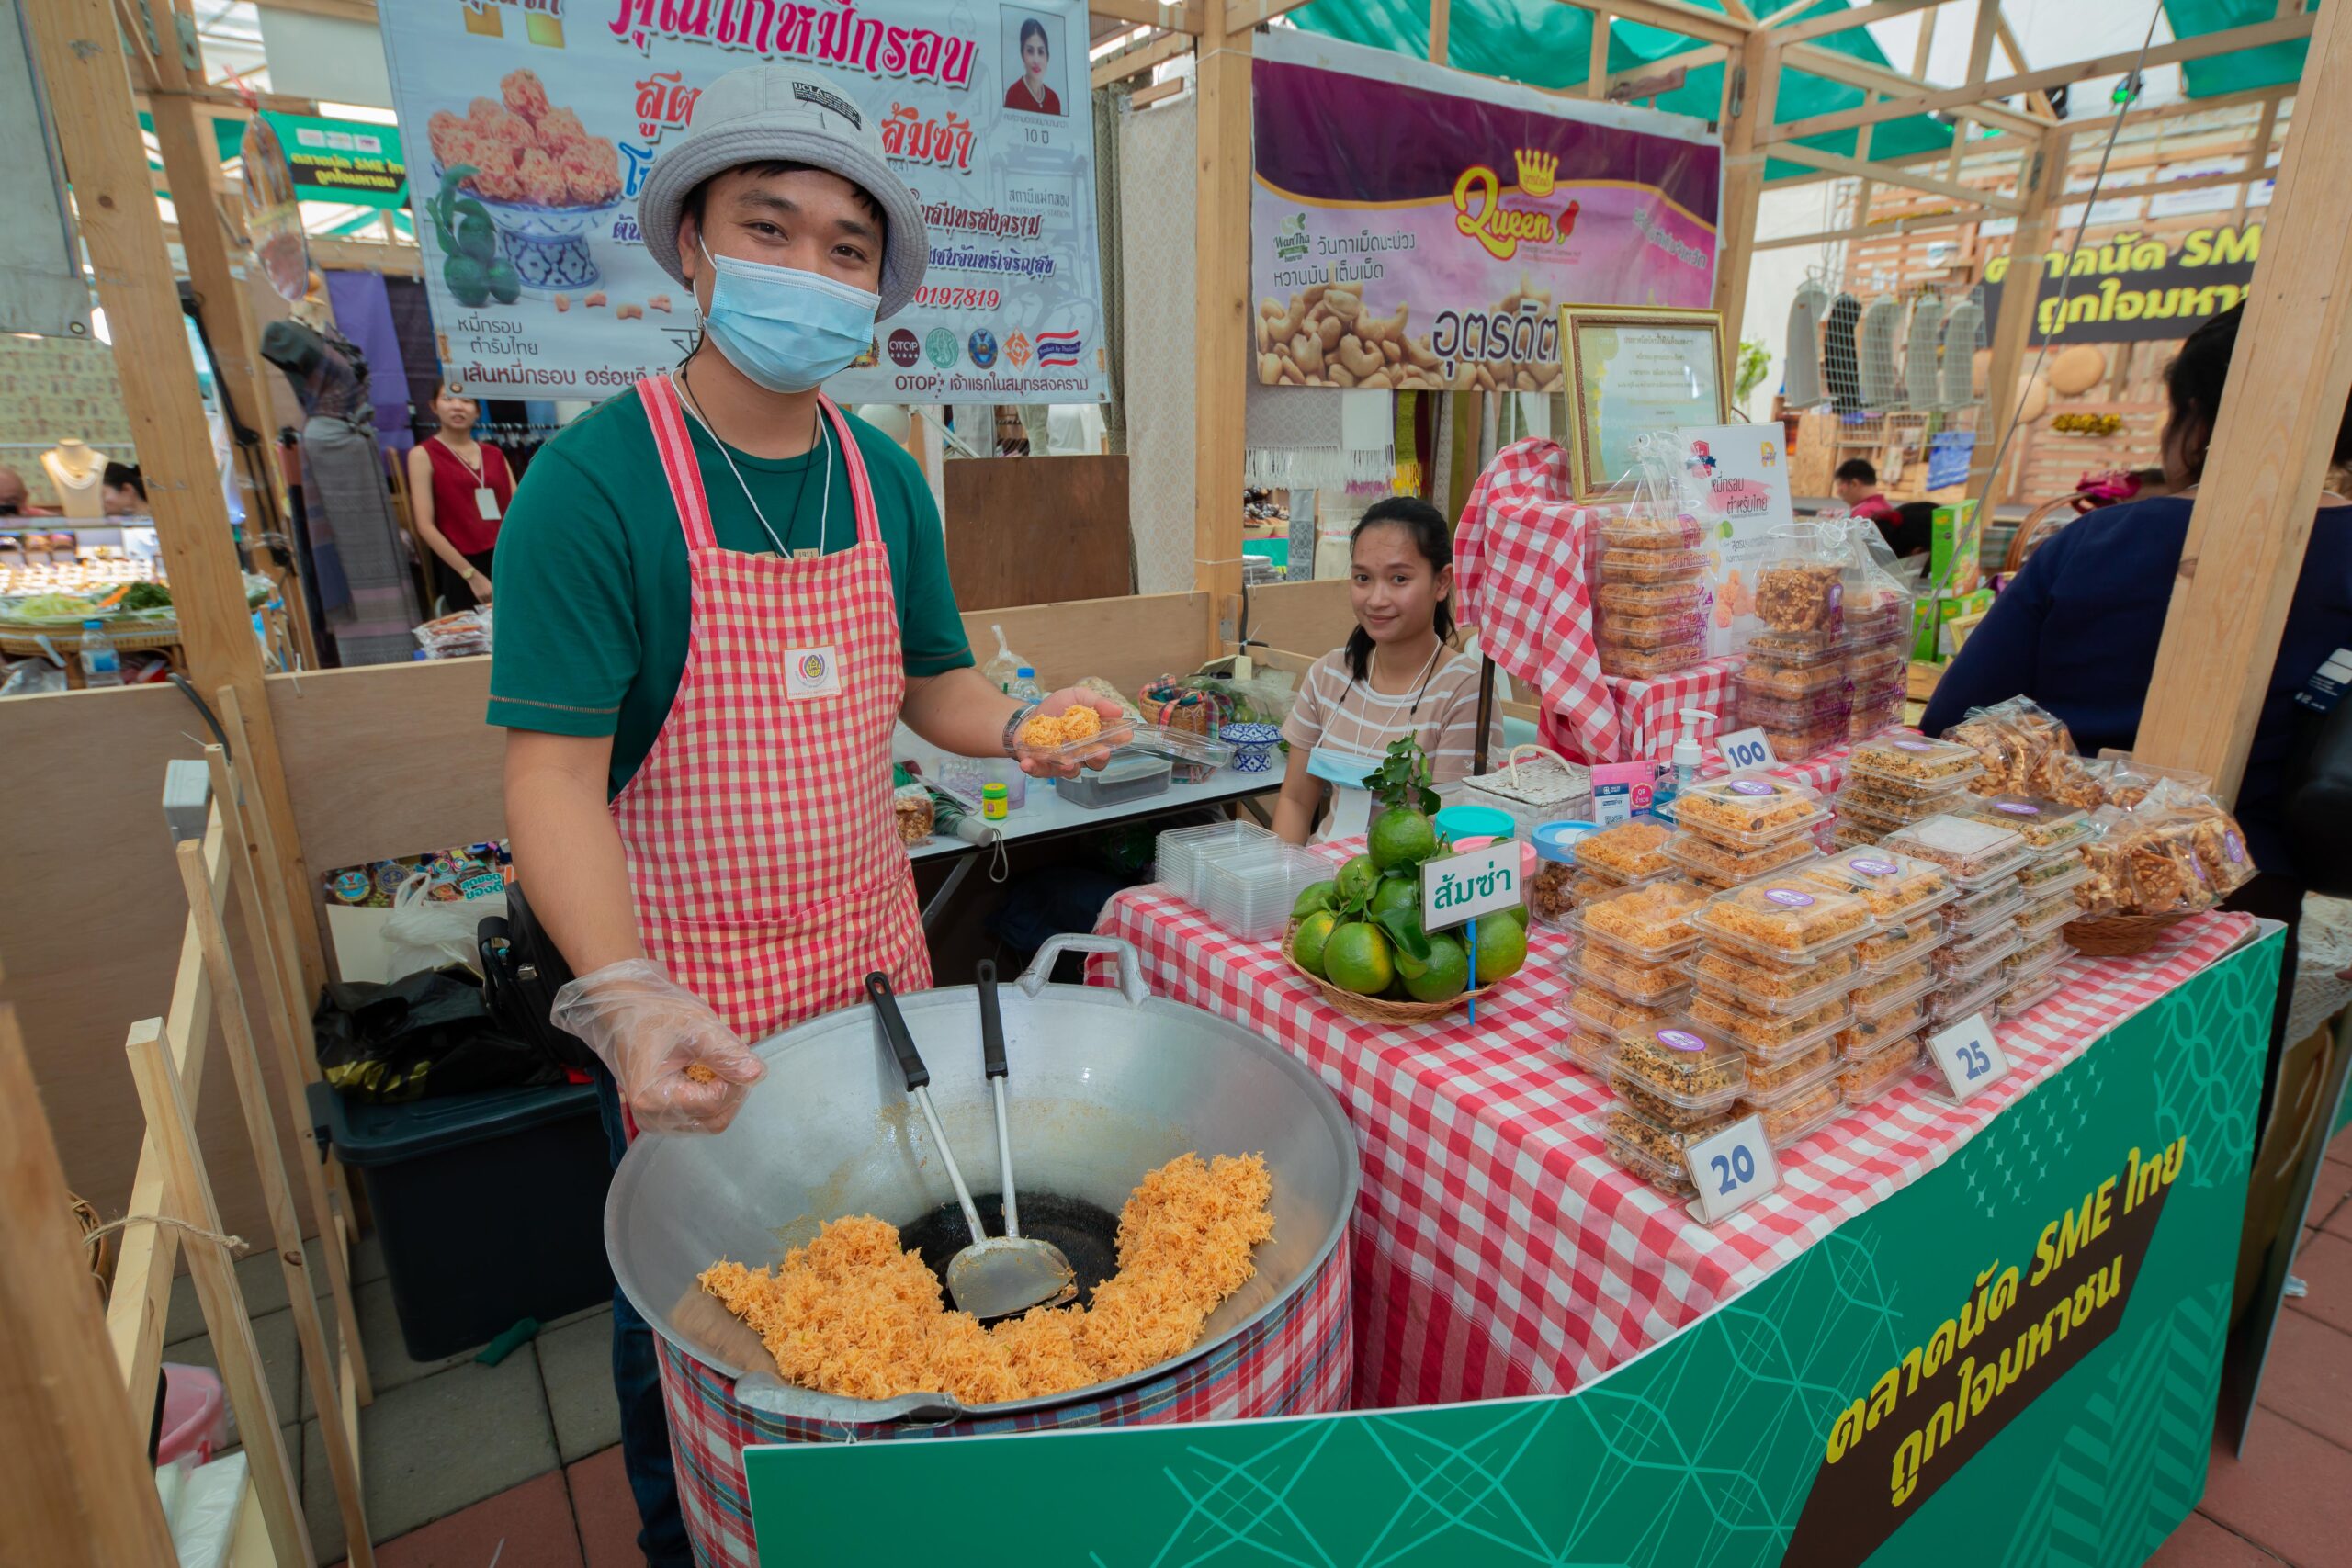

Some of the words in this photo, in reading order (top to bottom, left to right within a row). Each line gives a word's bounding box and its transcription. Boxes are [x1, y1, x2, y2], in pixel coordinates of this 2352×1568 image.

[793, 83, 824, 96] UCLA
[1024, 128, 1037, 143] 10
[1453, 164, 1554, 261] Queen
[2178, 223, 2263, 268] SM
[1274, 265, 1329, 287] หวานมัน
[1335, 257, 1384, 282] เต็มเม็ด
[914, 285, 1001, 308] 0197819
[2037, 277, 2251, 335] ถูกใจมหา
[458, 311, 523, 334] หมี่กรอบ
[470, 336, 538, 355] ตำรับไทย
[888, 341, 918, 351] OTOP
[1433, 304, 1559, 378] อุตรดิต
[463, 359, 576, 386] เส้นหมี่กรอบ
[895, 375, 937, 391] OTOP
[950, 371, 1089, 396] เจ้าแรกในสมุทรสงคราม
[1728, 741, 1766, 768] 100
[1434, 861, 1511, 909] ส้มซ่า
[1956, 1040, 1991, 1081] 25
[1711, 1145, 1755, 1195] 20
[1826, 1258, 2019, 1464] ตลาดนัด
[2030, 1174, 2117, 1287] SME
[2123, 1135, 2187, 1216] ไทย
[1891, 1255, 2123, 1507] ถูกใจมหาชน
